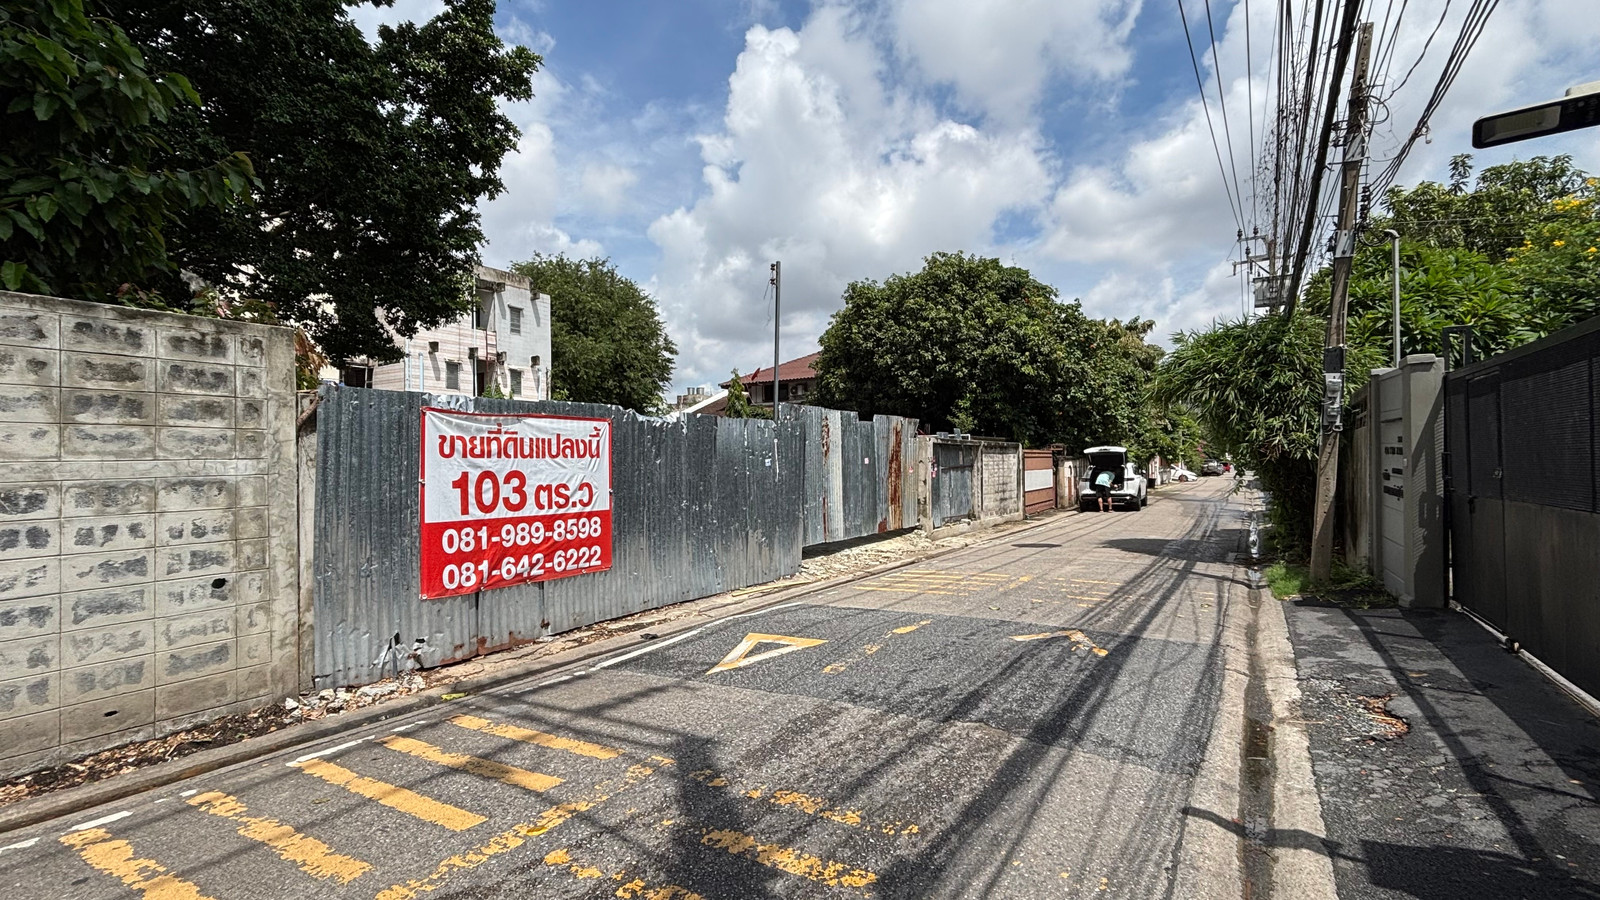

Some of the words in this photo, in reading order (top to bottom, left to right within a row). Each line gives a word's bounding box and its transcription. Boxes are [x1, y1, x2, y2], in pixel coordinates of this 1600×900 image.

[438, 423, 601, 459] ขายที่ดินแปลงนี้
[451, 470, 527, 515] 103
[534, 482, 593, 510] ตร.ว
[442, 517, 601, 554] 081-989-8598
[442, 545, 601, 589] 081-642-6222
